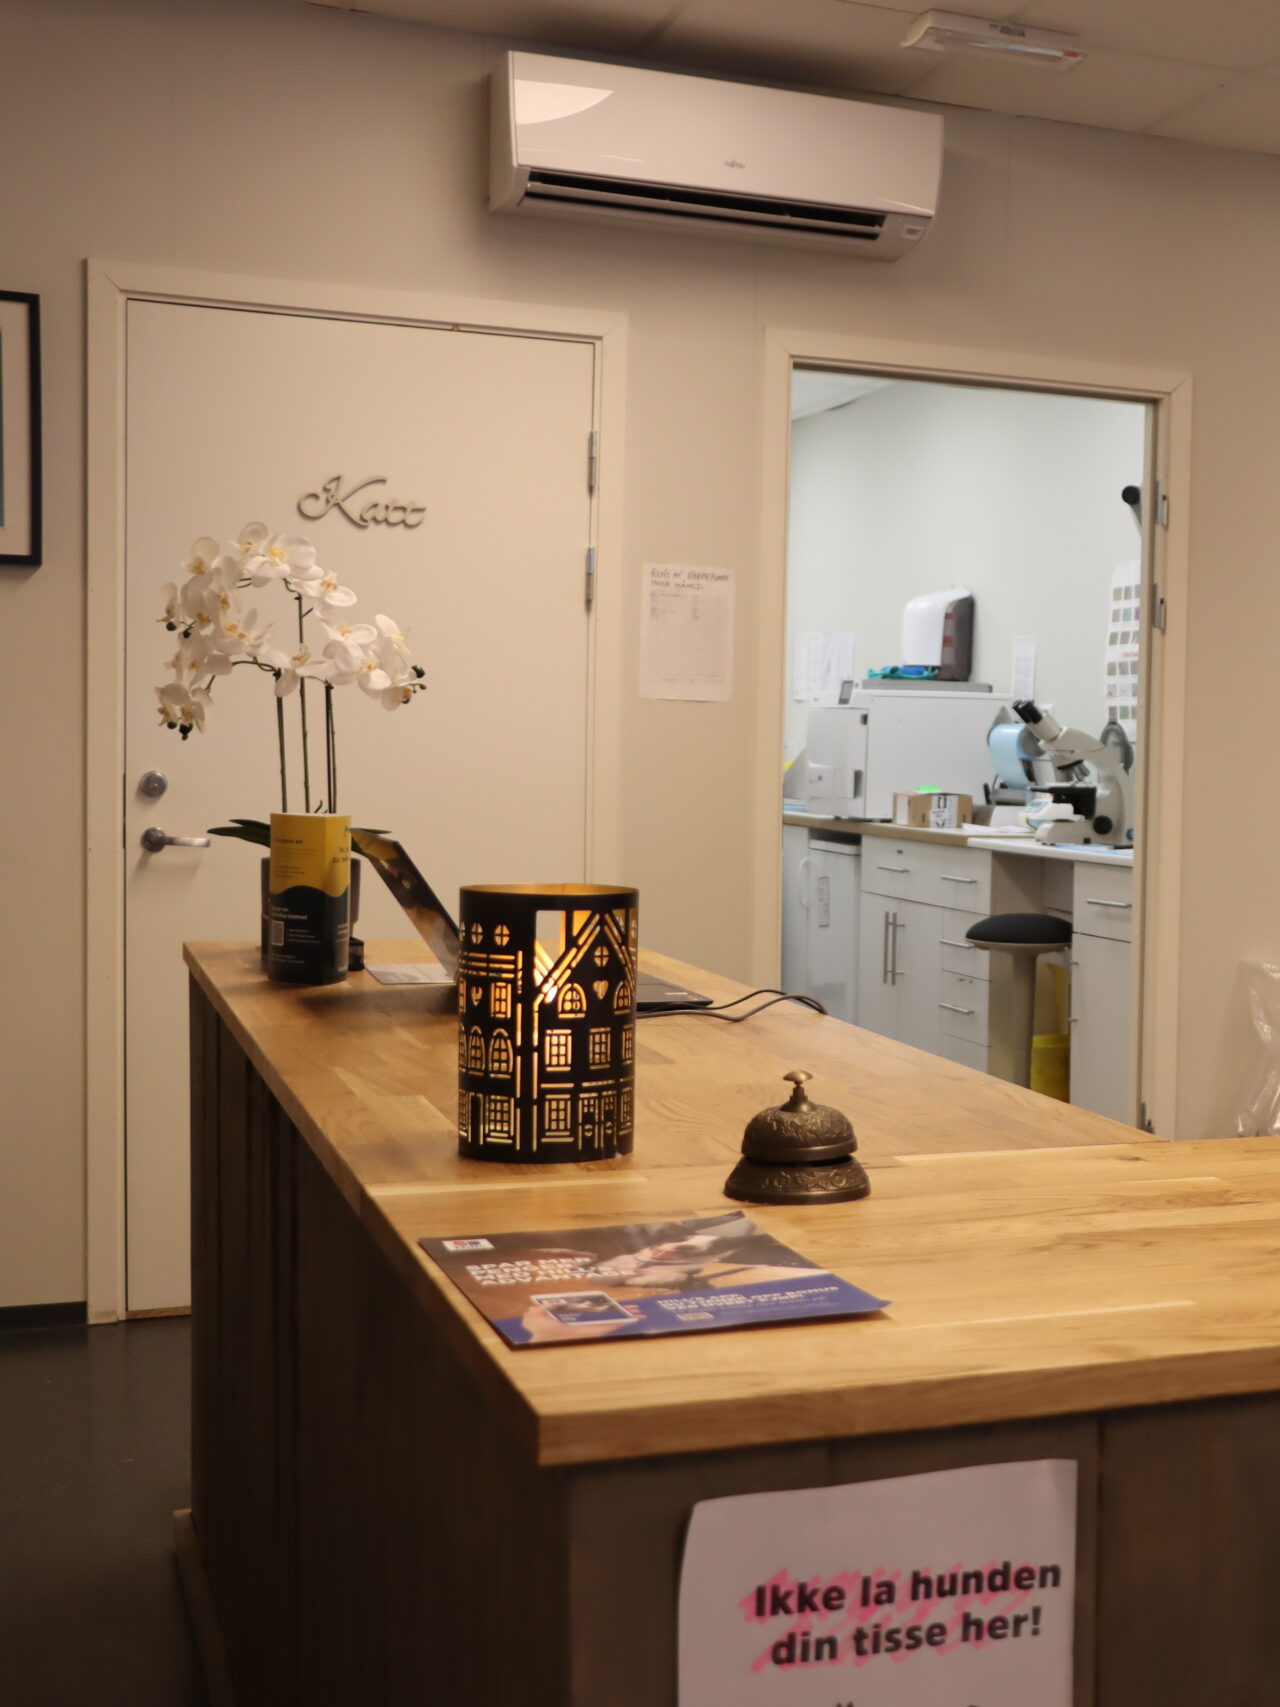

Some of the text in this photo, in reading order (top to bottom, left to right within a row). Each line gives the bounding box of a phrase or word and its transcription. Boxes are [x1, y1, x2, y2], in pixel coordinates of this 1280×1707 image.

[754, 1561, 1061, 1617] Ikke la hunden
[771, 1606, 1041, 1666] din tisse her!
